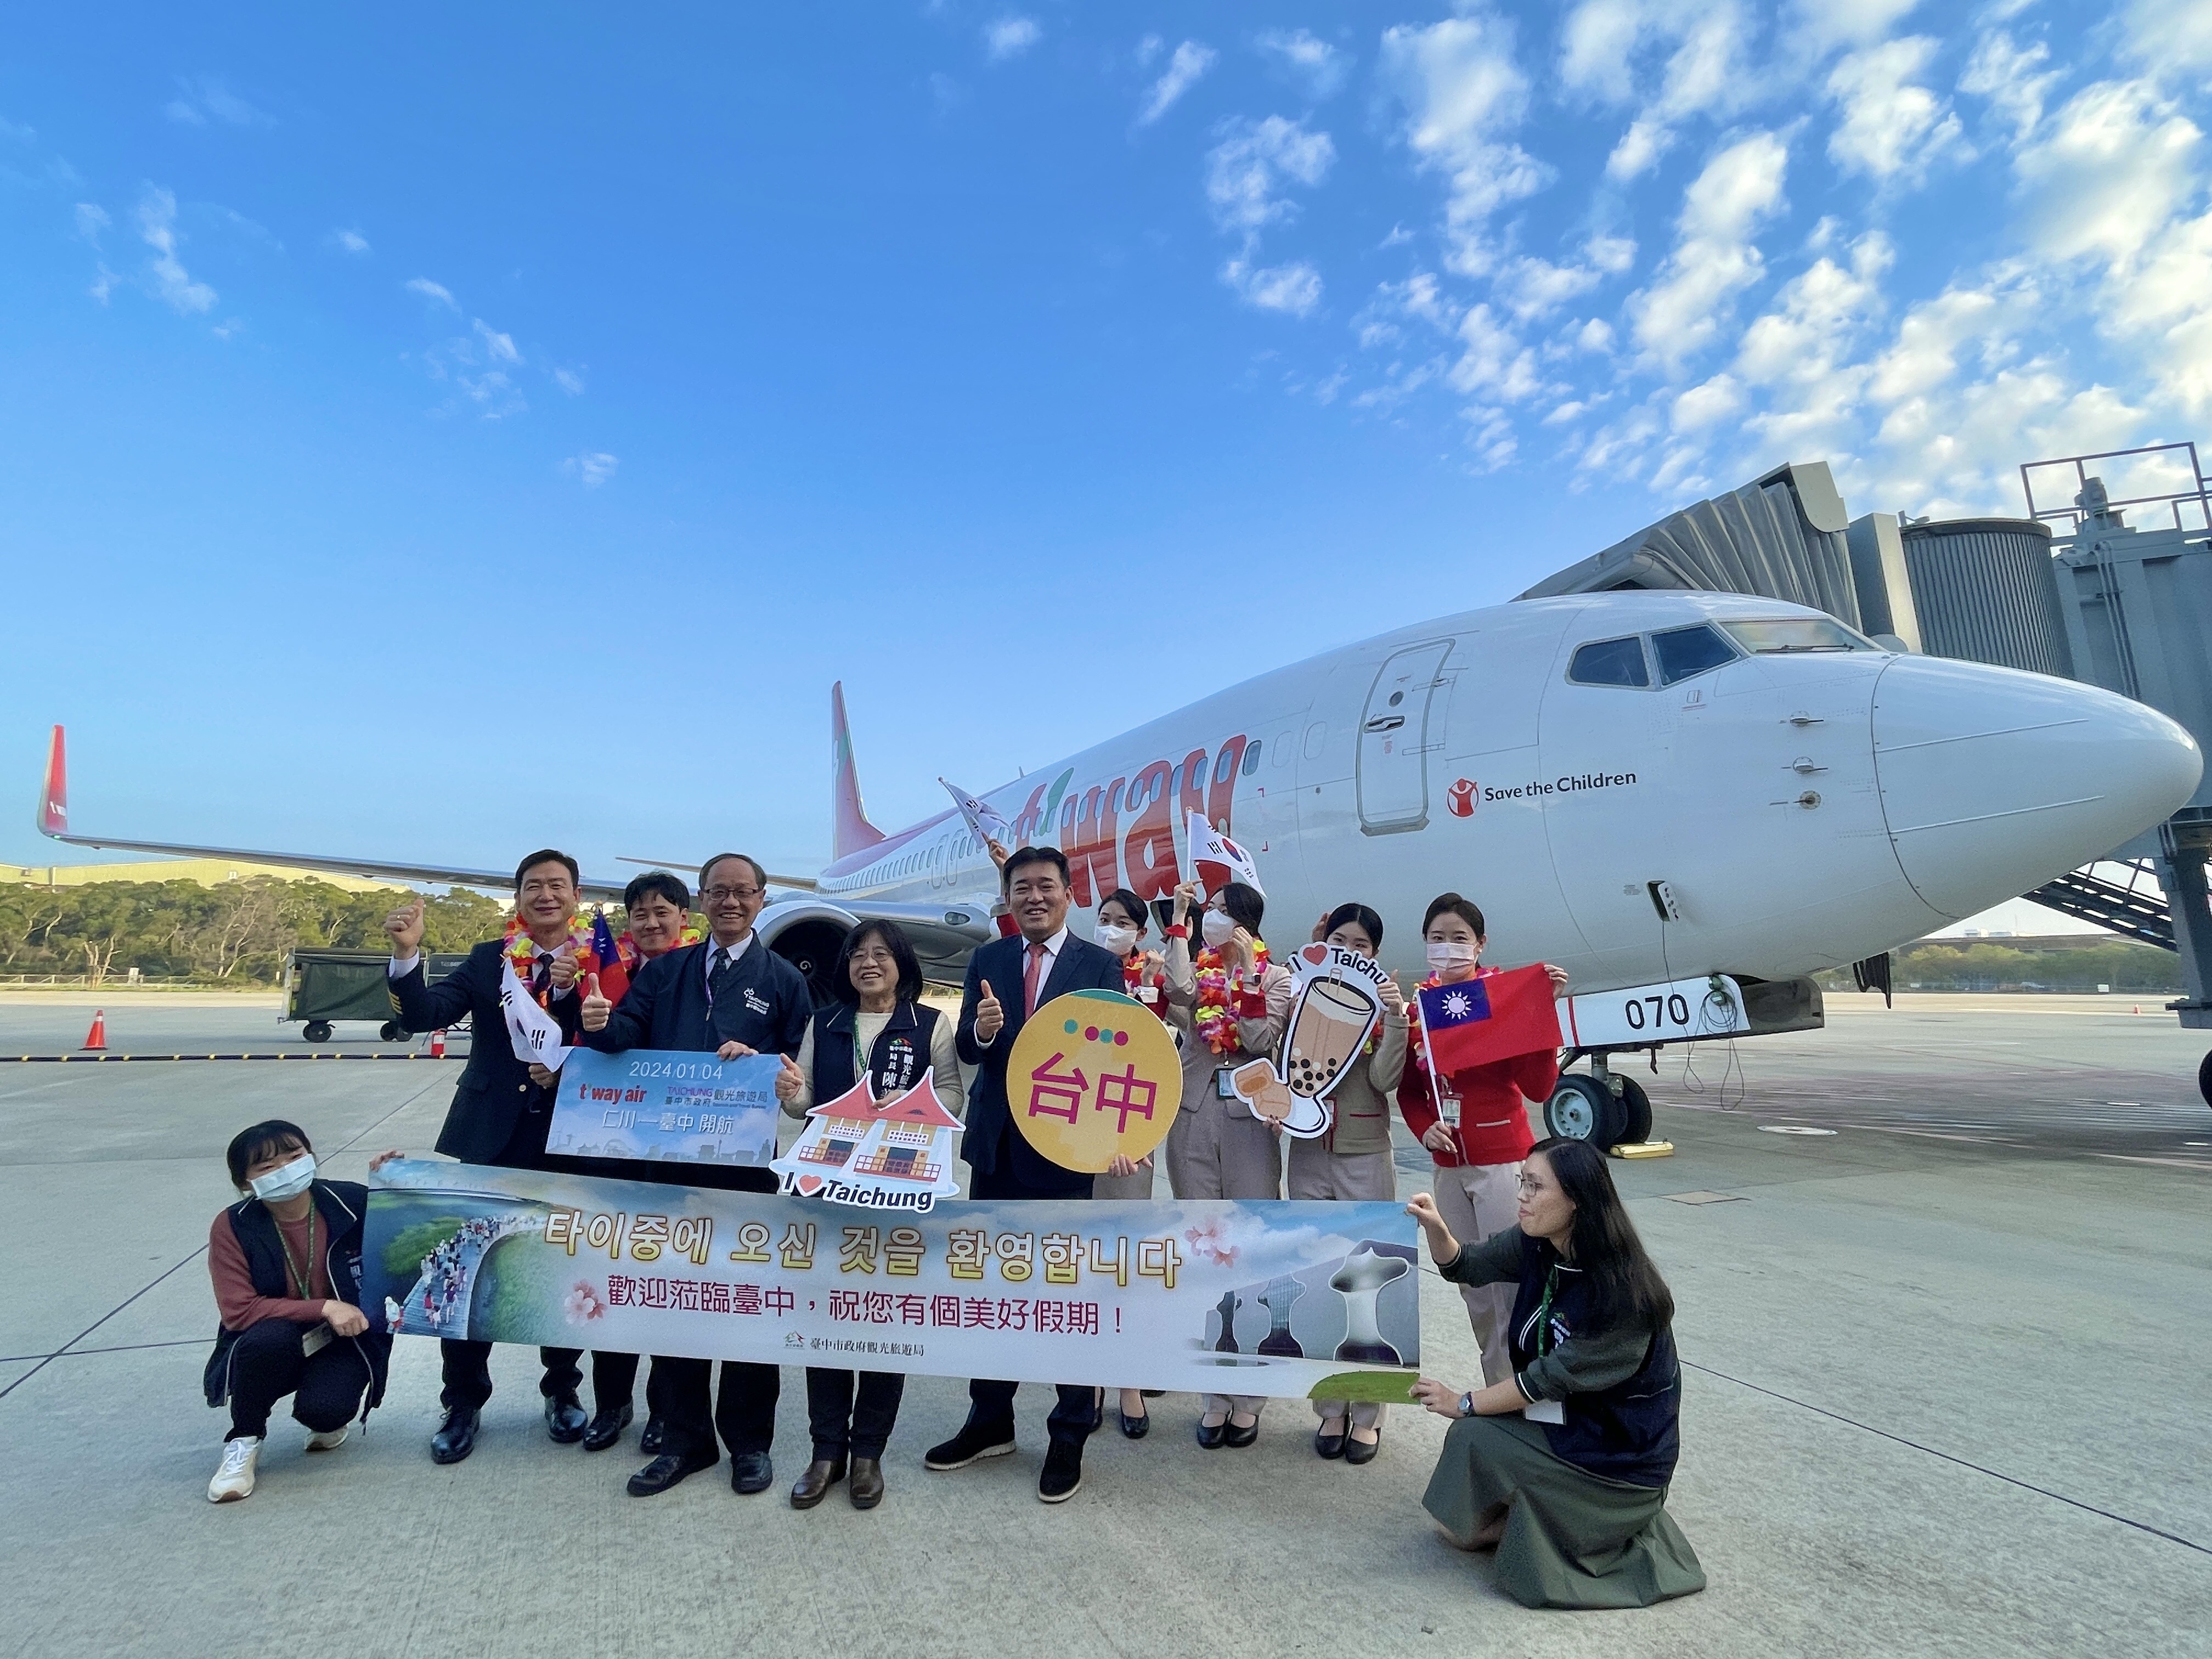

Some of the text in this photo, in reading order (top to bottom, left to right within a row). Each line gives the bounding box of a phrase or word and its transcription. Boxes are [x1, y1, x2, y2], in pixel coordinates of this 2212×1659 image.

[1485, 772, 1637, 801] Save the Children
[1291, 947, 1389, 984] I Taichu
[1625, 994, 1690, 1030] 070
[624, 1085, 647, 1103] air
[1028, 1052, 1158, 1133] 台中
[785, 1172, 932, 1210] I Taichung
[545, 1210, 1182, 1289] 타이중에 오신 것을 환영합니다
[810, 1337, 924, 1357] 臺中市政府觀光旅遊局
